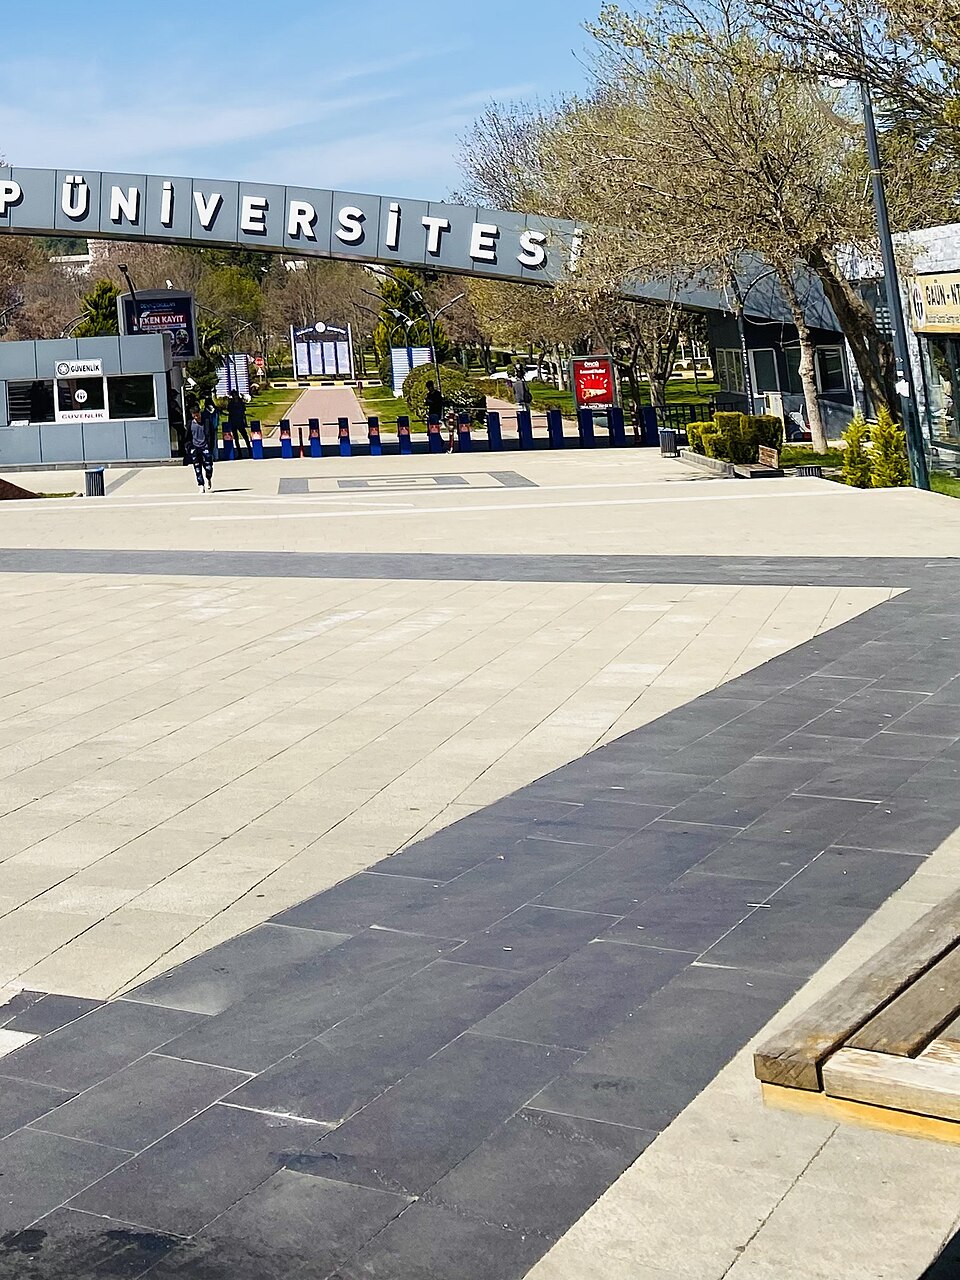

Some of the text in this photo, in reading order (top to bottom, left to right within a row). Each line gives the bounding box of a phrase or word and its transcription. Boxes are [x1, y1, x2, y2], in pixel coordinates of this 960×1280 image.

[61, 175, 583, 273] ÜNİVERSİTESİ
[161, 315, 184, 323] KAYIT
[70, 363, 100, 373] GÜVENLİK
